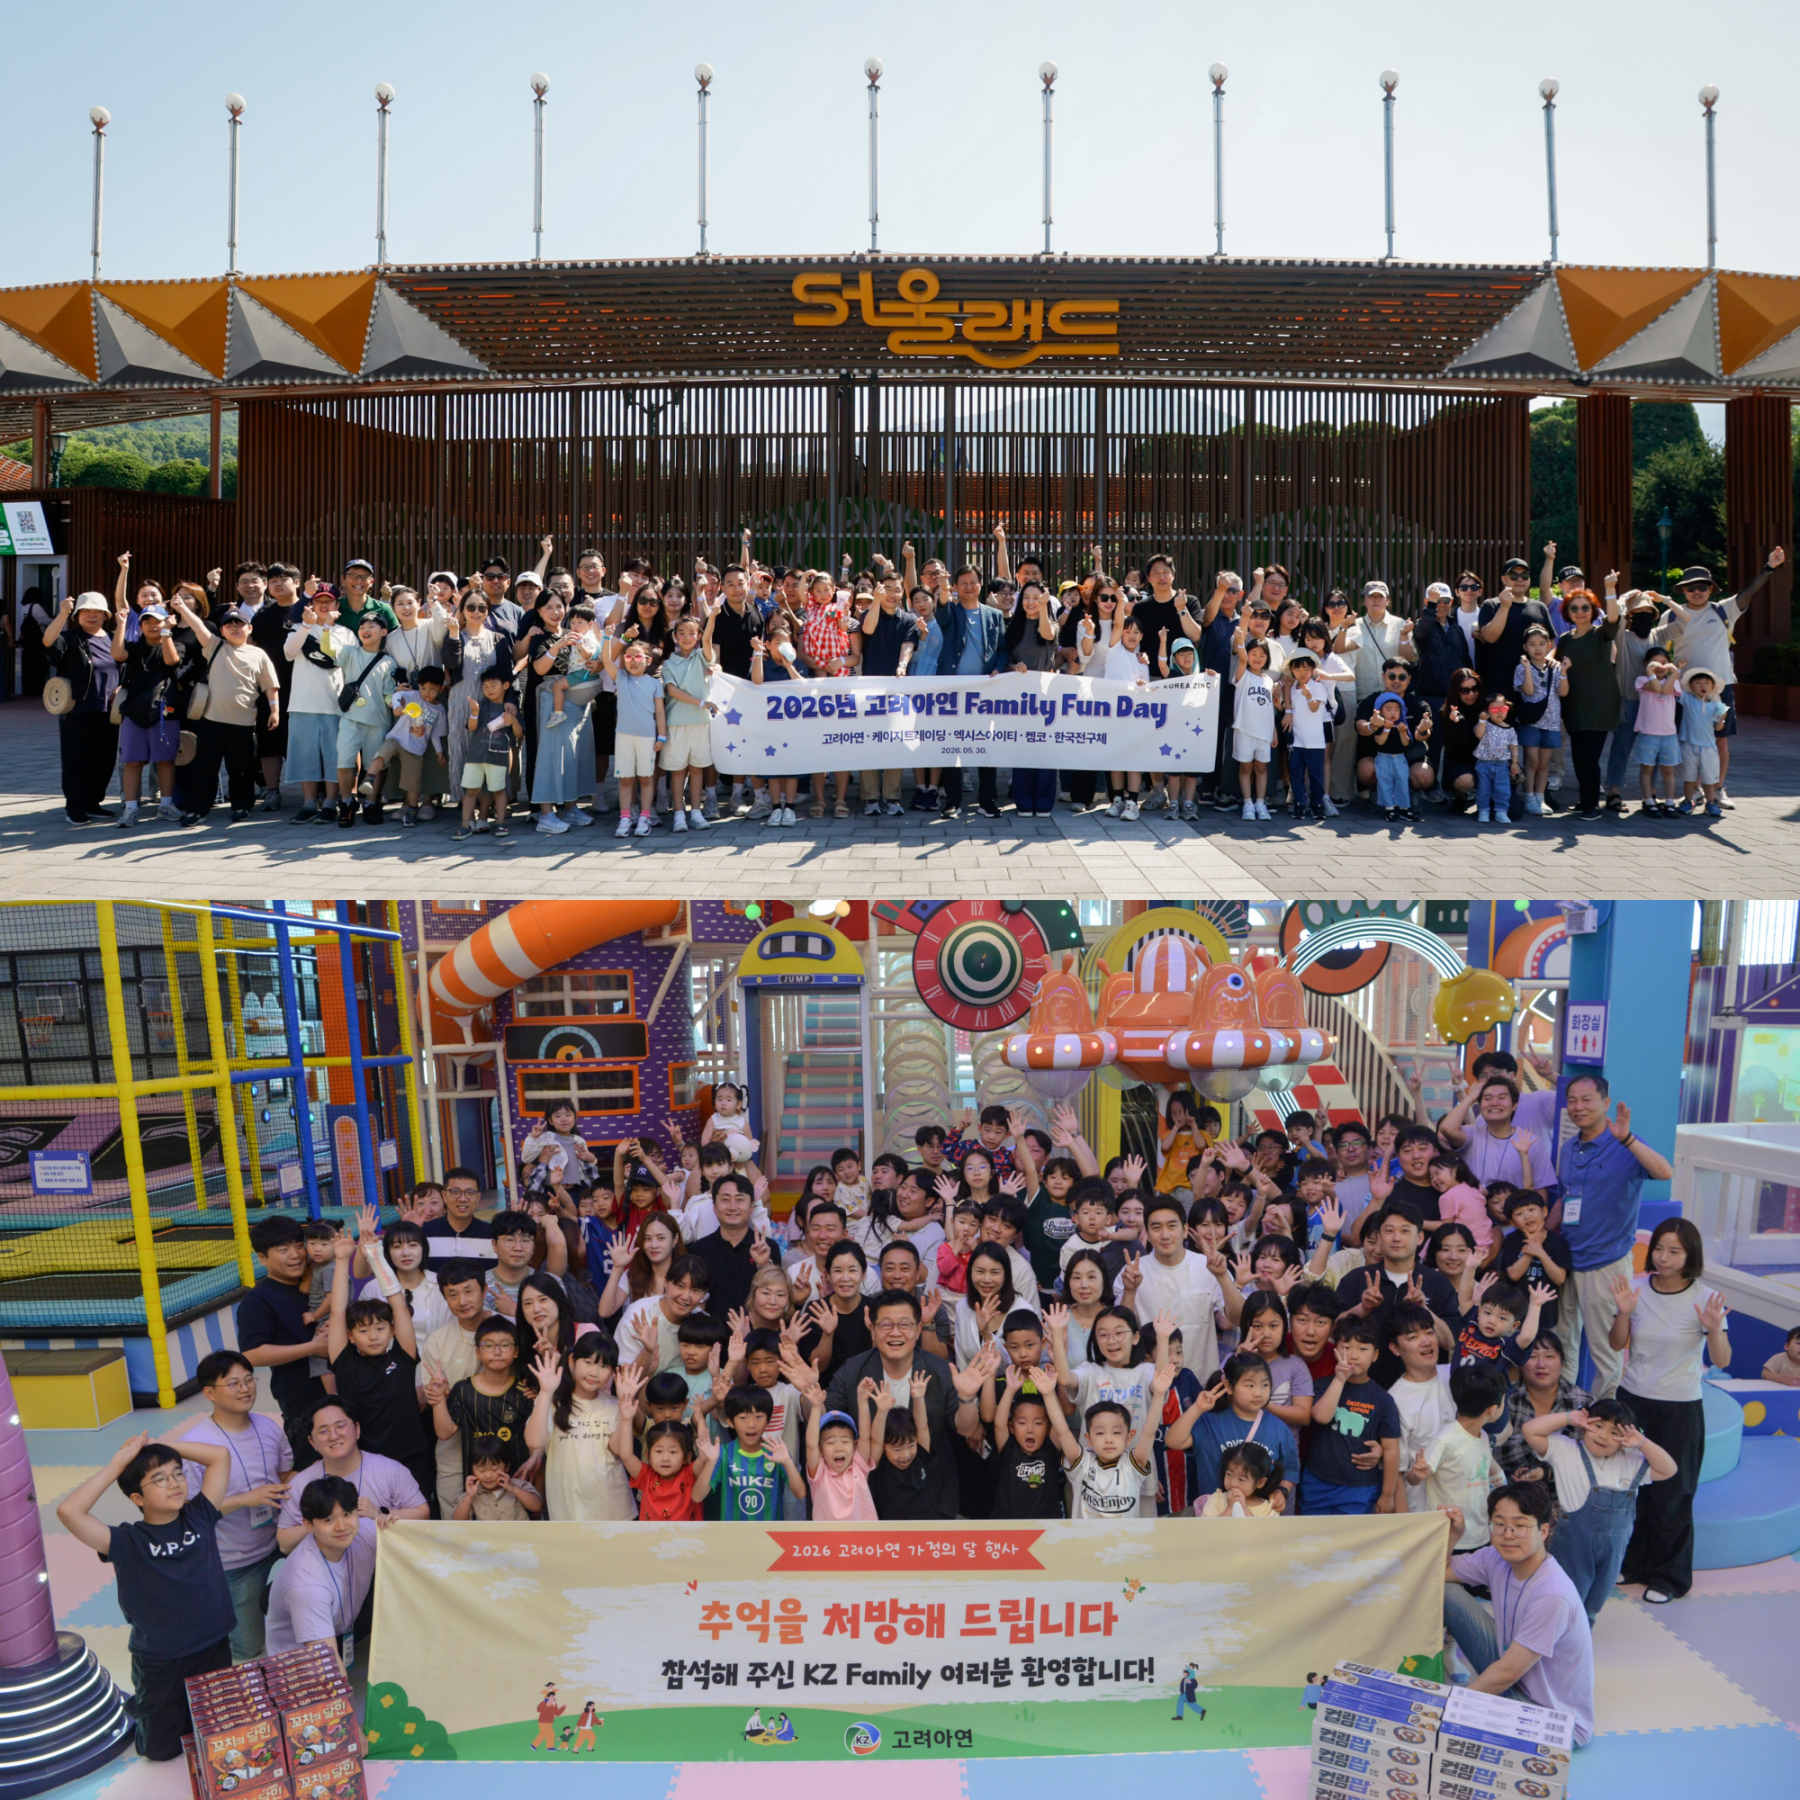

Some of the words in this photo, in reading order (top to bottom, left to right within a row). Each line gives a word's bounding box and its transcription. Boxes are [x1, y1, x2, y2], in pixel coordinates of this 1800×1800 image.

[791, 267, 1120, 369] 서울랜드
[1163, 682, 1191, 690] KOREA
[1193, 682, 1212, 690] ZINC
[766, 693, 858, 721] 2026년
[864, 691, 960, 717] 고려아연
[964, 691, 1057, 727] Family
[1061, 693, 1112, 718] Fun
[1116, 695, 1169, 730] Day
[822, 731, 865, 745] 고려아연
[872, 729, 946, 744] 케이지트레이딩
[953, 729, 1018, 743] 엑시스아이티
[1025, 730, 1047, 744] 켐코
[1054, 731, 1108, 745] 한국전구체
[941, 746, 962, 755] 2026.
[962, 746, 975, 755] 05.
[975, 746, 987, 755] 30.
[783, 975, 810, 983] JUMP
[1571, 1013, 1601, 1032] 화장실
[728, 1476, 774, 1489] NIKE
[744, 1494, 759, 1509] 90
[792, 1545, 831, 1557] 2026
[838, 1542, 900, 1558] 고려아연
[907, 1541, 956, 1559] 가정의
[962, 1541, 977, 1558] 달
[985, 1540, 1019, 1559] 행사
[698, 1597, 808, 1645] 추억을
[822, 1597, 946, 1645] 처방해
[959, 1597, 1119, 1645] 드립니다
[661, 1659, 738, 1690] 참석해
[747, 1660, 795, 1690] 주신
[803, 1663, 838, 1685] KZ
[846, 1661, 932, 1691] Family
[940, 1657, 1014, 1688] 여러분
[1021, 1656, 1155, 1688] 환영합니다!
[1343, 1661, 1395, 1680] 컬링팝
[289, 1712, 321, 1729] 꼬치의
[323, 1702, 347, 1719] 달인
[1324, 1707, 1378, 1733] 컬링팝
[211, 1736, 245, 1753] 꼬치의
[246, 1725, 271, 1743] 달인
[855, 1735, 870, 1745] KZ
[892, 1728, 973, 1750] 고려아연
[1319, 1727, 1373, 1754] 컬링팝
[1446, 1738, 1506, 1765] 컬링팝
[1318, 1747, 1372, 1774] 컬링팝
[1440, 1759, 1498, 1786] 컬링팝
[298, 1772, 330, 1789] 꼬치의
[332, 1761, 355, 1779] 달인
[1318, 1769, 1372, 1795] 컬링팝
